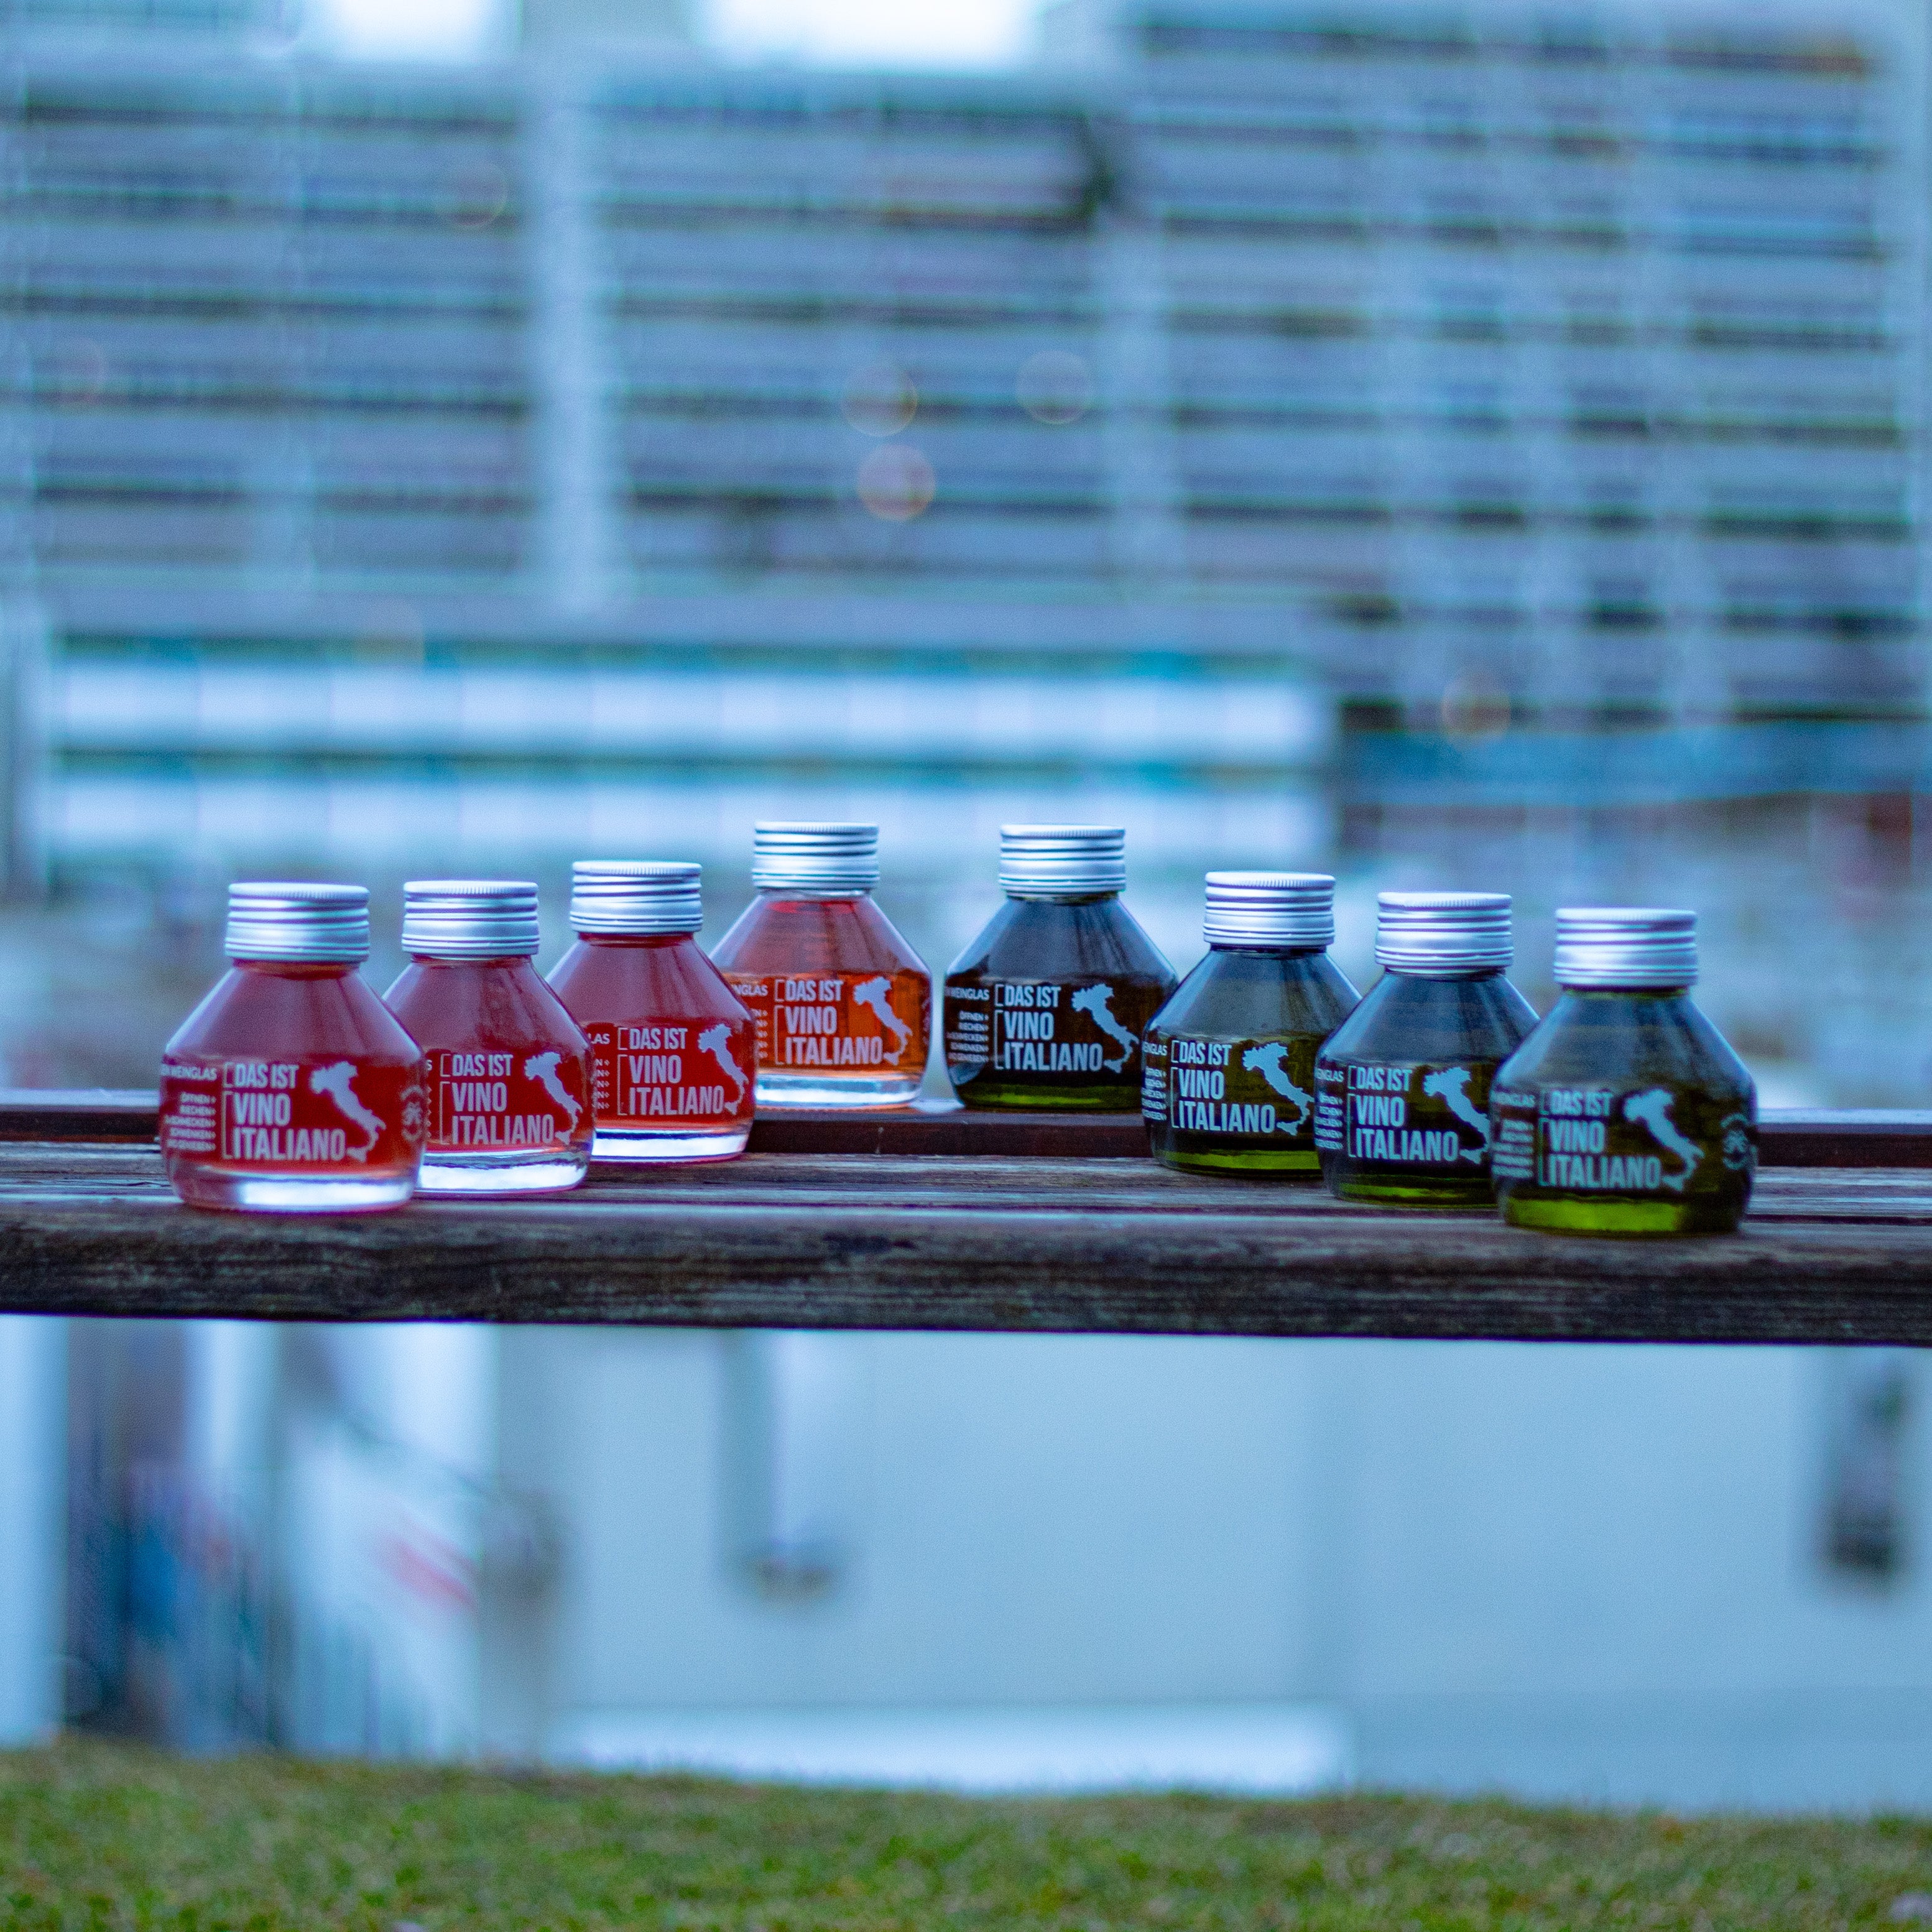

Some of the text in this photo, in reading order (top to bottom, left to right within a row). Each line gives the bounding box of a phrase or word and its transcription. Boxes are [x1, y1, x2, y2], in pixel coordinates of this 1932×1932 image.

[785, 979, 844, 1002] DAS IST
[1004, 985, 1061, 1008] DAS IST
[785, 1005, 838, 1035] VINO
[1004, 1011, 1055, 1041] VINO
[629, 1028, 661, 1050] DAS
[664, 1028, 688, 1050] IST
[785, 1036, 884, 1065] ITALIANO
[1179, 1042, 1232, 1066] DAS IST
[452, 1054, 485, 1076] DAS
[488, 1054, 514, 1076] IST
[629, 1055, 682, 1084] VINO
[1004, 1042, 1104, 1071] ITALIANO
[234, 1063, 299, 1089] DAS IST
[1178, 1068, 1225, 1100] VINO
[1356, 1066, 1413, 1092] DAS IST
[234, 1093, 291, 1126] VINO
[451, 1082, 507, 1112] VINO
[629, 1085, 724, 1116] ITALIANO
[1356, 1094, 1405, 1127] VINO
[1551, 1090, 1614, 1117] DAS IST
[451, 1114, 555, 1145] ITALIANO
[1179, 1100, 1275, 1133] ITALIANO
[234, 1128, 346, 1161] ITALIANO
[1356, 1128, 1459, 1162] ITALIANO
[1550, 1119, 1606, 1153] VINO
[1548, 1154, 1662, 1189] ITALIANO
